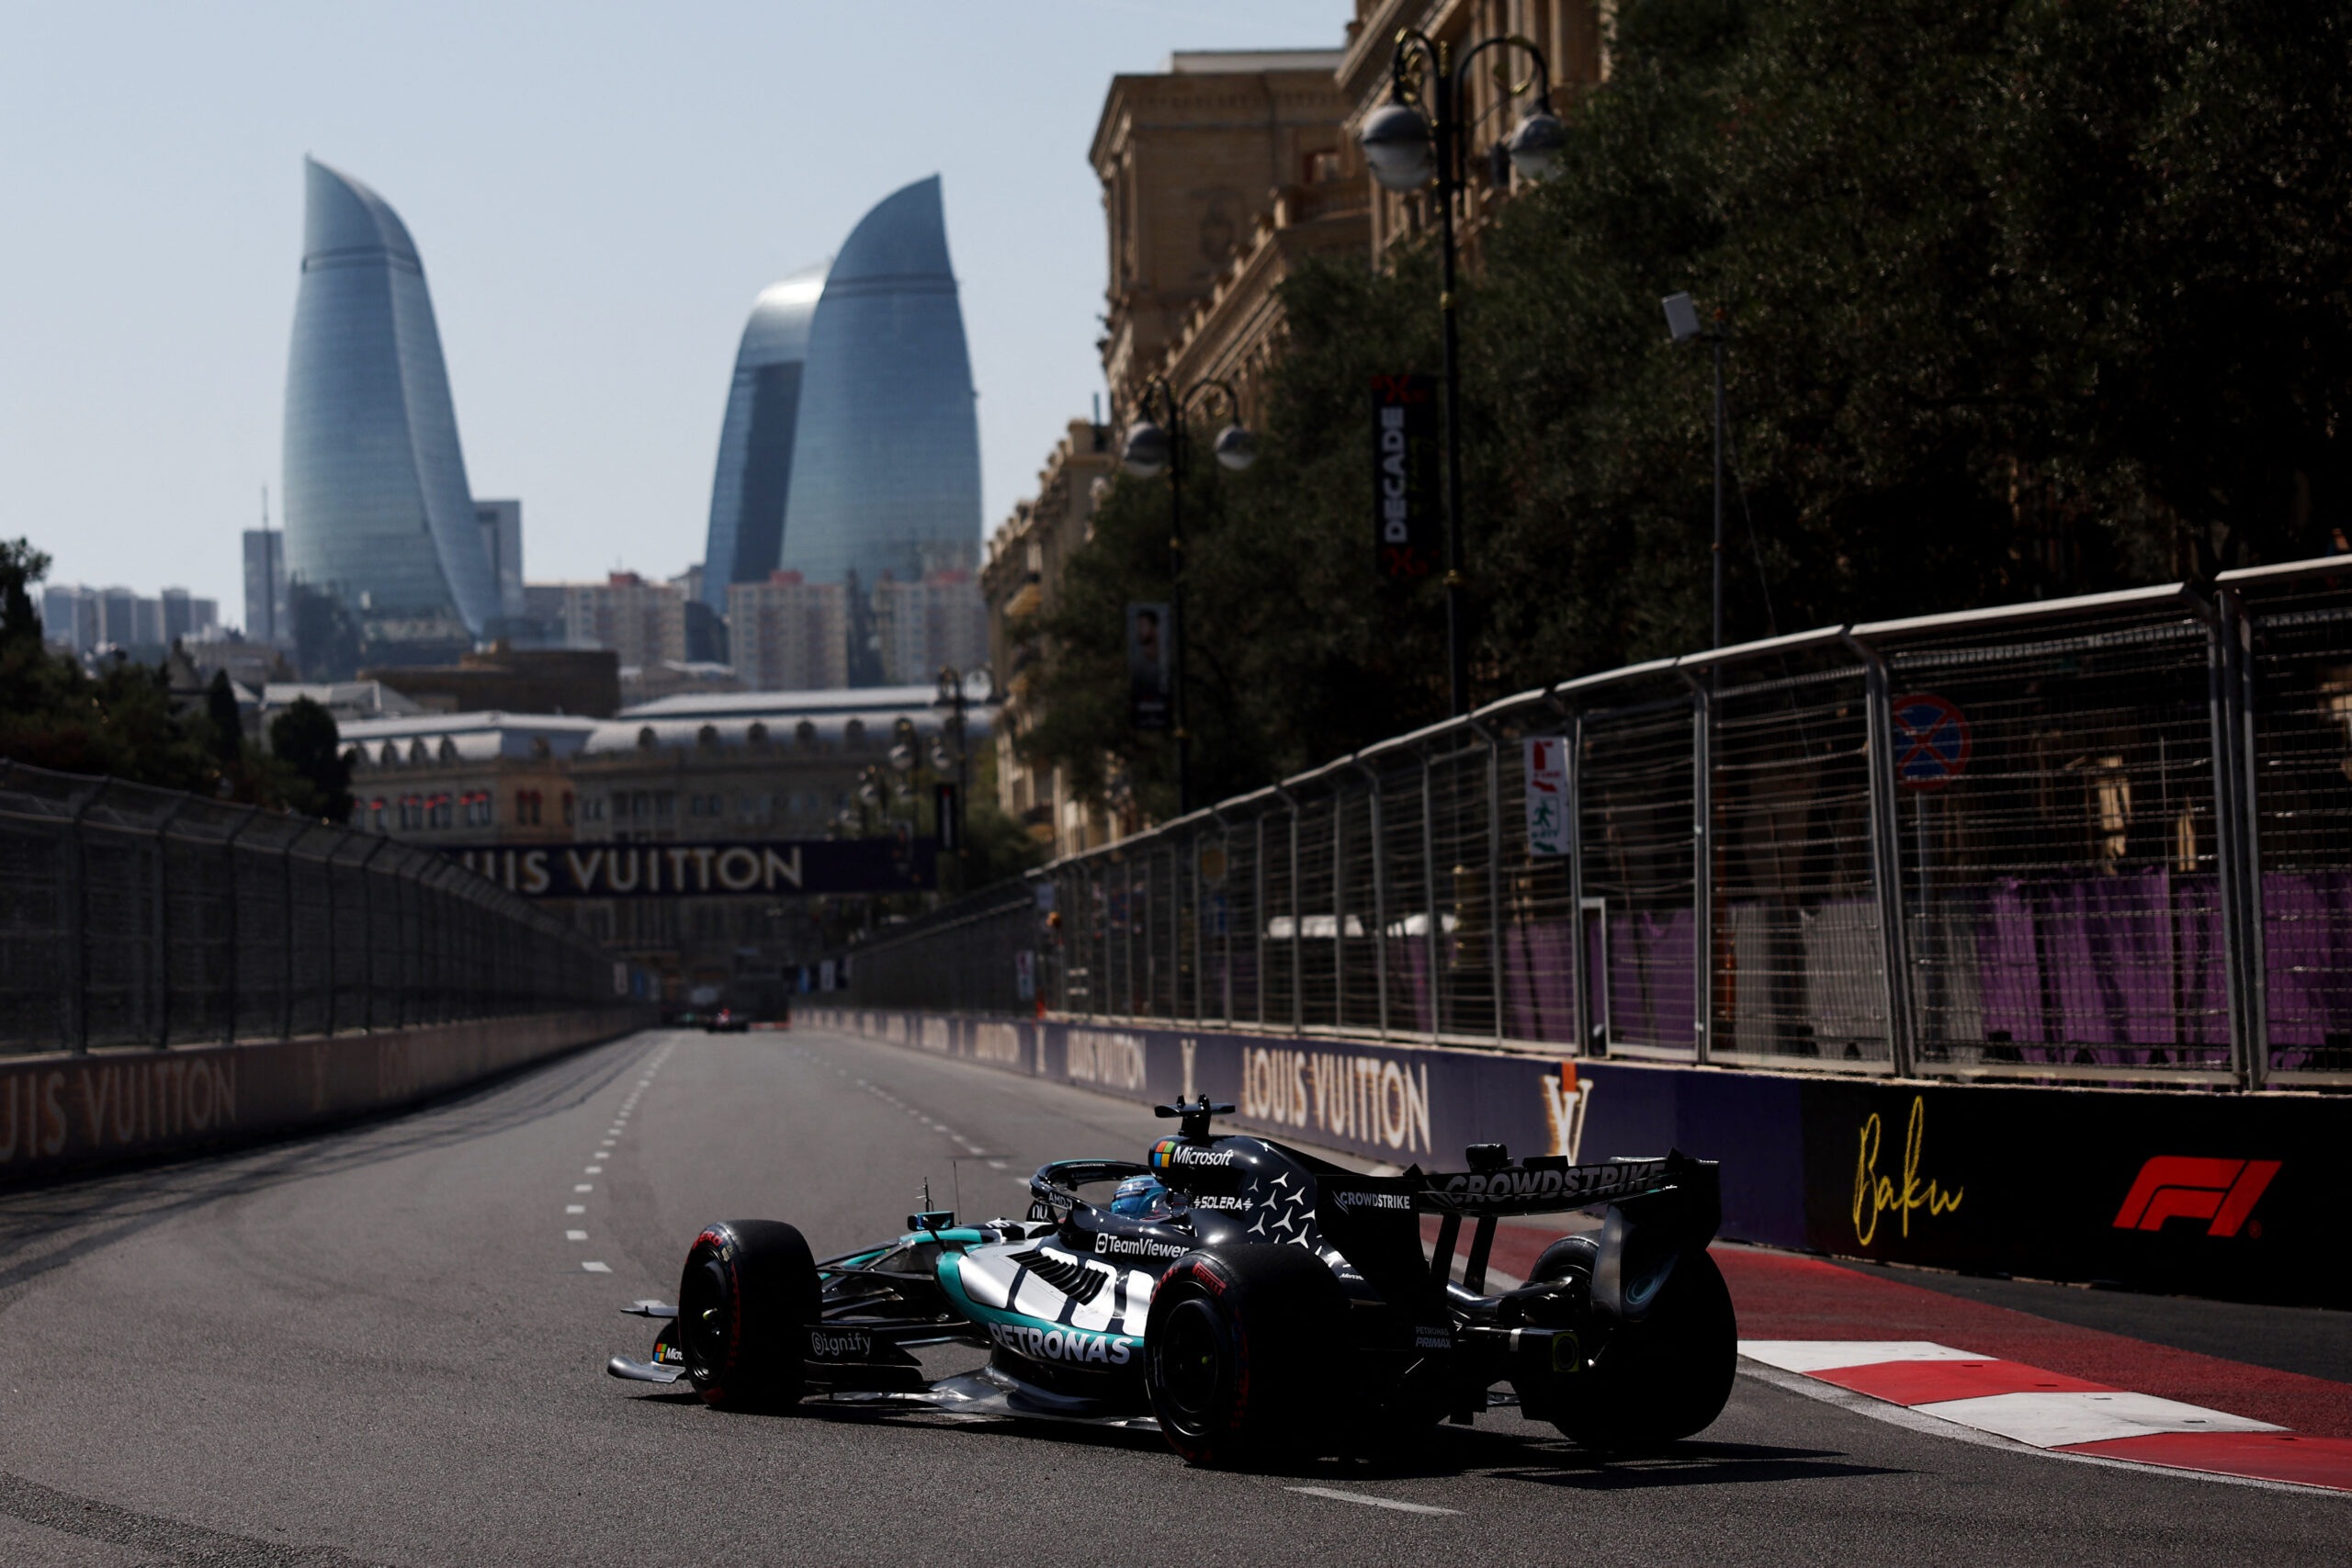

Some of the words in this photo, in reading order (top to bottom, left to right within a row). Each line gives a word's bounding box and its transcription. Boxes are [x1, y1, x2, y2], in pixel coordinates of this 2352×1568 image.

[1379, 405, 1409, 544] DECADE
[565, 847, 803, 894] VUITTON
[81, 1056, 238, 1147] VUITTON
[1242, 1046, 1307, 1129] LOUIS
[1310, 1051, 1431, 1156] VUITTON
[1172, 1145, 1234, 1167] Microsoft
[1853, 1095, 1964, 1246] Baku
[1201, 1195, 1243, 1211] SOLERA
[1340, 1190, 1411, 1211] CROWDSTRIKE
[1442, 1161, 1666, 1205] CROWDSTRIKE
[1108, 1235, 1190, 1258] TeamViewer
[988, 1322, 1135, 1365] PETRONAS
[1414, 1336, 1453, 1349] PRIMAX
